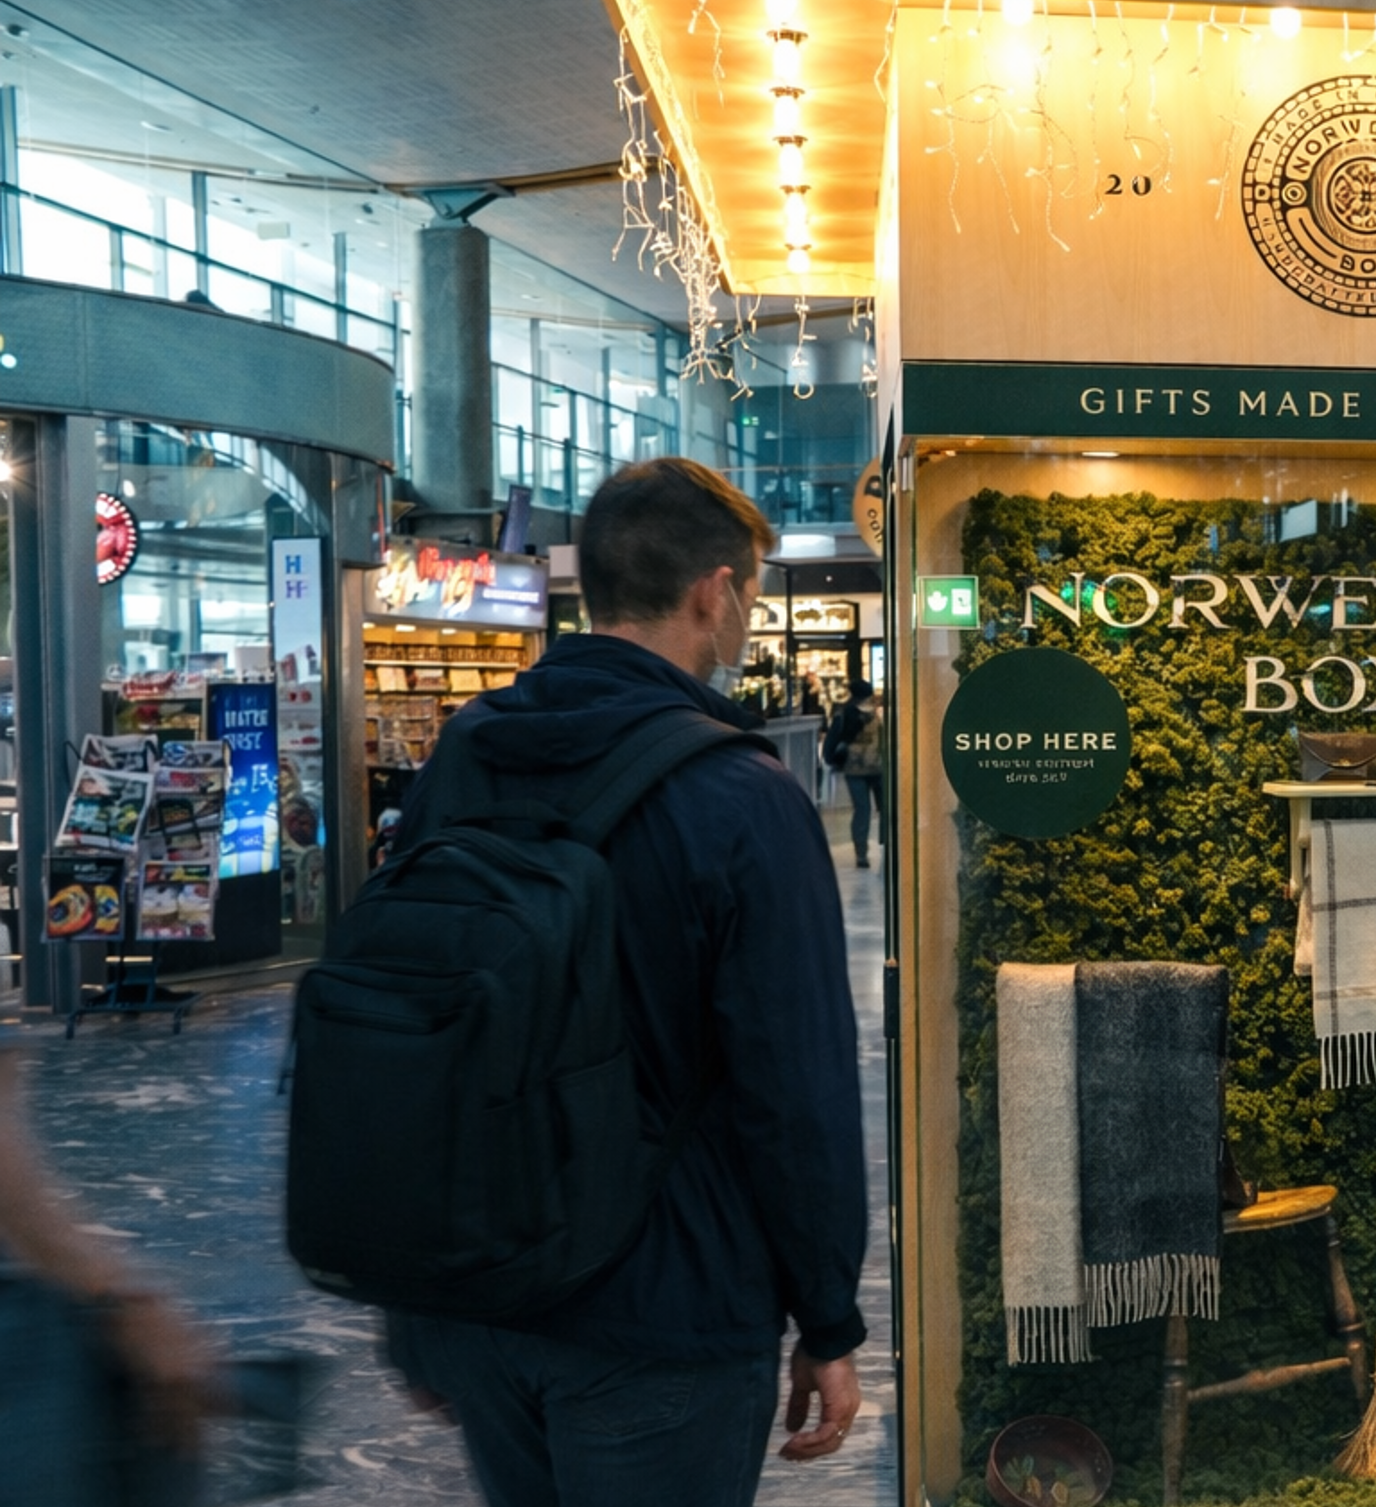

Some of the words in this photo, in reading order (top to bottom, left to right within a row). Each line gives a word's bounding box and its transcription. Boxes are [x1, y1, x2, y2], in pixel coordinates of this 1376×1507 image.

[1105, 174, 1151, 197] 20
[1080, 388, 1211, 415] GIFTS
[1238, 390, 1361, 418] MADE
[955, 733, 1032, 751] SHOP
[1044, 733, 1117, 750] HERE
